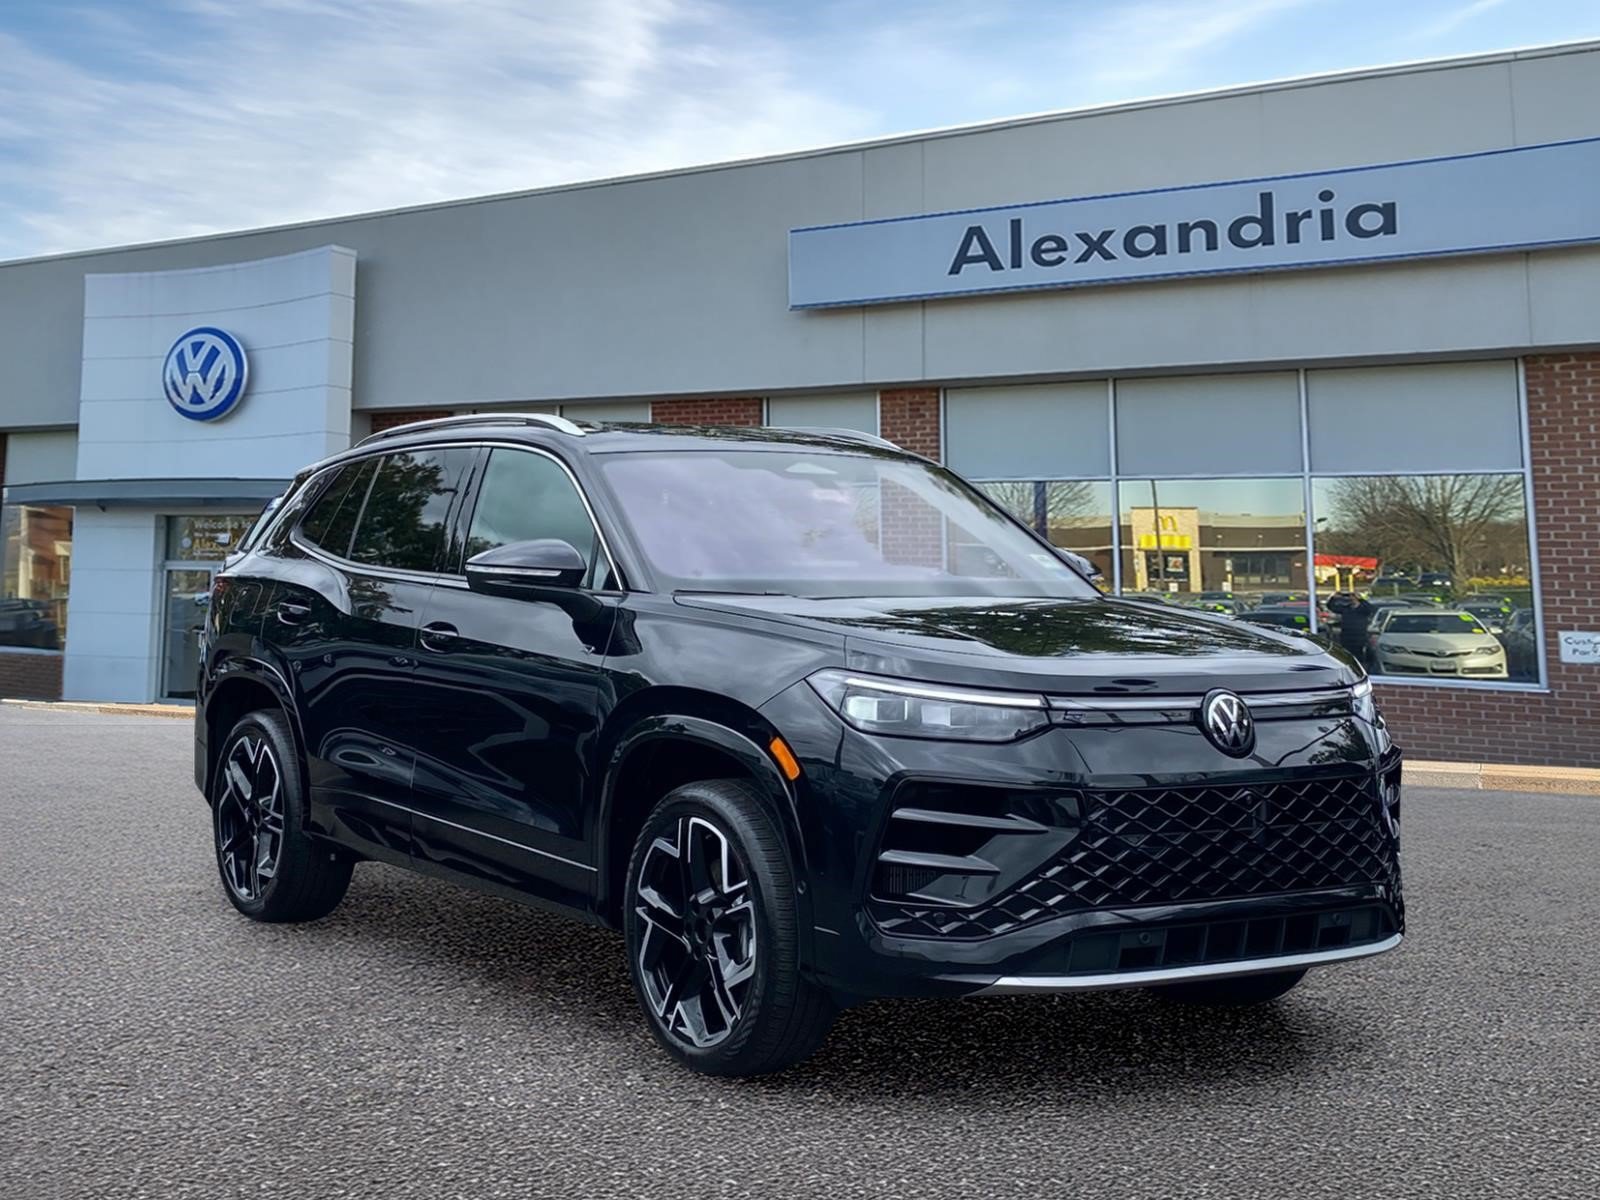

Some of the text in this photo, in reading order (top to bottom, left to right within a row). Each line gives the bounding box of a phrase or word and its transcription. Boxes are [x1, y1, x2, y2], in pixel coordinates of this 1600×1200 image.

[948, 189, 1398, 276] Alexandria
[168, 333, 237, 412] VW
[1208, 693, 1251, 752] VW
